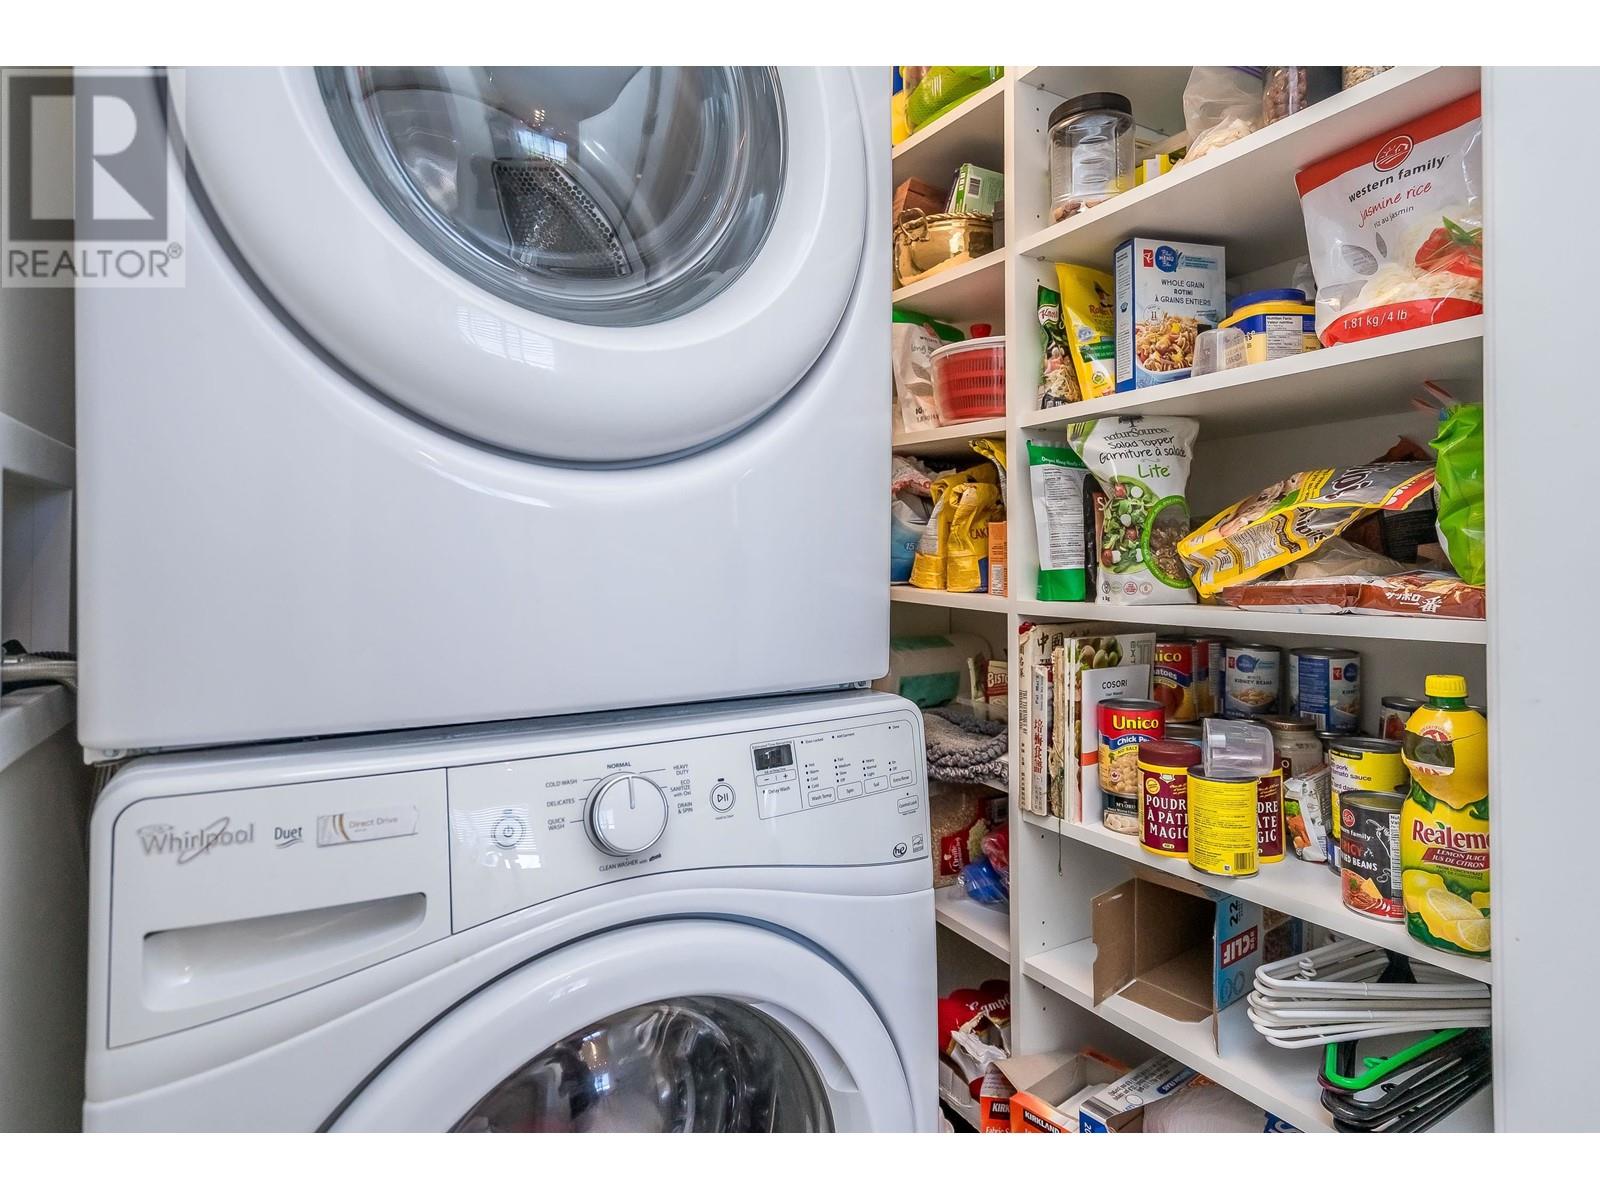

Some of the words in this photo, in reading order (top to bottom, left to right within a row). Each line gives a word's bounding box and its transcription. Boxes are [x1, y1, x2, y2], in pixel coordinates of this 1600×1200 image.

[1349, 176, 1394, 203] western
[1398, 156, 1446, 181] family
[1358, 193, 1402, 229] jasmine
[1407, 181, 1432, 200] rice
[1381, 216, 1389, 225] au
[1389, 205, 1415, 222] jasmin
[1161, 280, 1184, 288] WHOLE
[1186, 281, 1205, 289] GRAIN
[1160, 296, 1185, 304] GRAINS
[1185, 298, 1212, 307] ENTIERS
[1343, 318, 1363, 330] 1.81
[1396, 310, 1408, 320] lb
[1104, 427, 1169, 441] naturSource
[1108, 440, 1139, 450] Salad
[1138, 435, 1175, 448] Topper
[1099, 447, 1153, 465] Garniture
[1137, 463, 1171, 479] Lite
[969, 528, 988, 539] CAK
[1155, 668, 1178, 680] atoes
[1101, 680, 1128, 690] COSORI
[1112, 714, 1160, 731] Unico
[1116, 736, 1137, 747] Chick
[606, 761, 632, 769] NORMAL
[1350, 774, 1372, 782] sauce
[546, 798, 575, 807] DELICATES
[1146, 795, 1187, 811] POUDR
[1257, 801, 1279, 814] DRE
[547, 816, 566, 825] QUICK
[548, 823, 565, 831] WASH
[137, 823, 255, 859] Whirlpool
[273, 827, 303, 841] Duet
[1257, 829, 1277, 844] GIC
[1350, 828, 1372, 842] family
[1412, 819, 1489, 851] ReaLem
[1436, 848, 1466, 859] LEMON
[599, 863, 617, 872] CLEAN
[617, 858, 639, 869] WASHER
[1352, 857, 1378, 872] BEANS
[1432, 854, 1446, 862] JUS
[1445, 857, 1455, 865] DE
[1455, 858, 1485, 869] CITRON
[1222, 934, 1250, 965] CLIF
[992, 1102, 1010, 1113] KIRK
[1024, 1110, 1061, 1134] KIRKLAND
